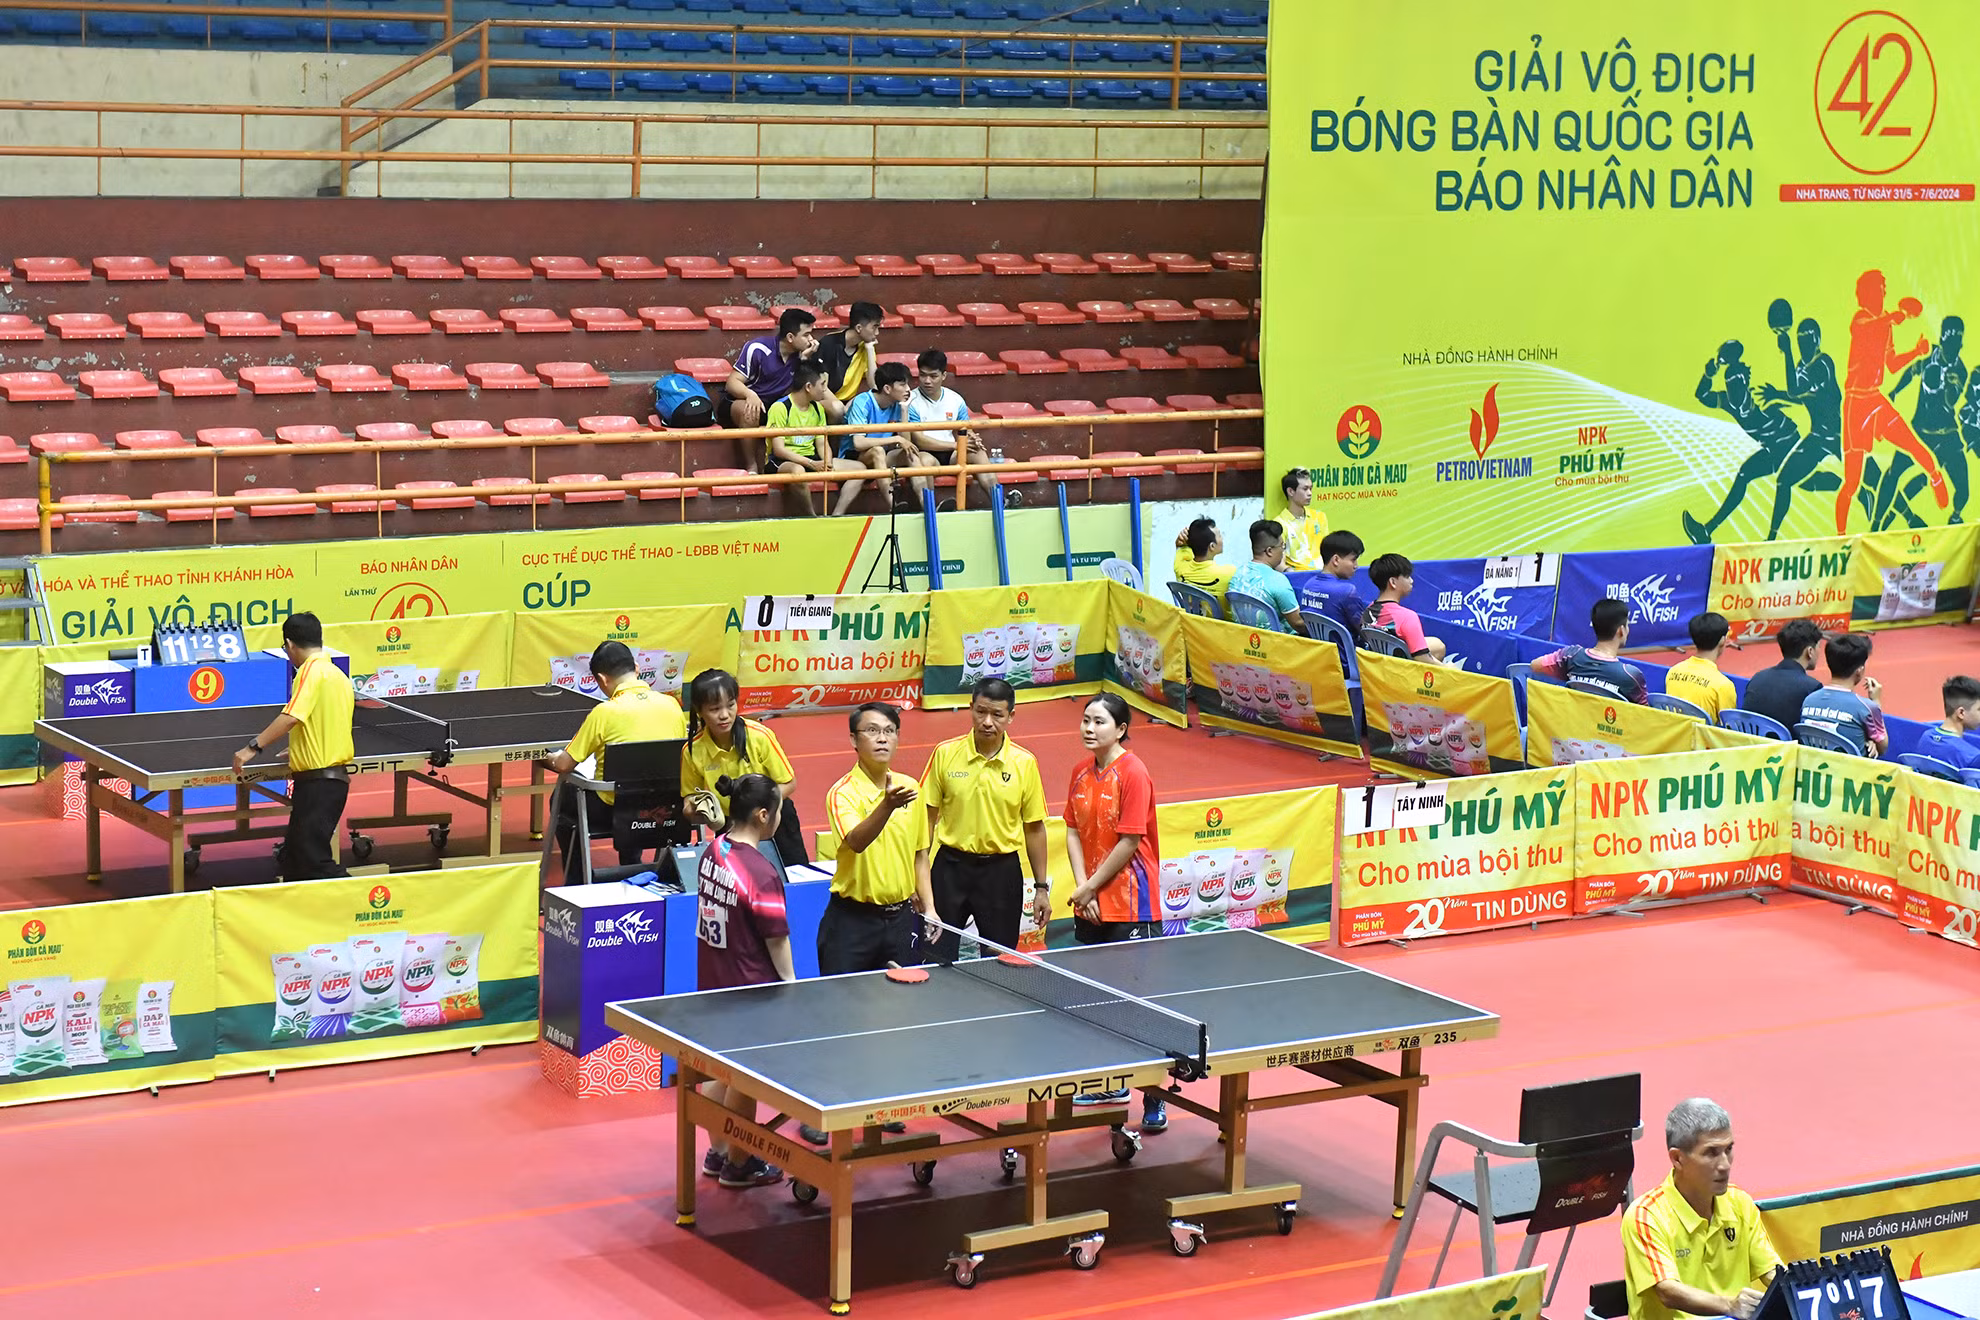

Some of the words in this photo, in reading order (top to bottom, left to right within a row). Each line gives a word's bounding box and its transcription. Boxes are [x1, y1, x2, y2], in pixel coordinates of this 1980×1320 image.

[1475, 34, 1562, 92] GIẢI
[1581, 37, 1636, 93] VÔ
[1652, 52, 1754, 103] ĐỊCH
[1827, 32, 1912, 136] 42
[1311, 96, 1436, 152] BÓNG
[1452, 96, 1539, 151] BÀN
[1554, 89, 1672, 152] QUỐC
[1686, 111, 1753, 150] GIA
[1436, 156, 1523, 211] BÁO
[1538, 154, 1655, 210] NHÂN
[1670, 154, 1752, 208] DÂN
[1796, 189, 1816, 199] NHA
[1818, 188, 1851, 200] TRANG,
[1853, 186, 1866, 199] TỪ
[1867, 186, 1892, 199] NGÀY
[1893, 188, 1912, 199] 31/5
[1920, 188, 1960, 199] 7/6/2024
[1403, 348, 1431, 365] NHÀ
[1436, 345, 1473, 364] ĐỒNG
[1478, 346, 1514, 362] HÀNH
[1518, 344, 1558, 361] CHÍNH
[1578, 426, 1607, 446] NPK
[1436, 457, 1532, 482] PETROVIETNAM
[1560, 449, 1594, 473] PHÚ
[1600, 447, 1625, 471] MỸ
[1310, 464, 1339, 488] PHÂN
[1343, 463, 1364, 486] BÓN
[1367, 462, 1381, 485] CÀ
[1385, 463, 1407, 483] MAU
[1555, 476, 1574, 486] Cho
[1614, 474, 1629, 483] thu
[1317, 493, 1331, 502] HẠT
[1333, 491, 1356, 501] NGỌC
[1358, 489, 1374, 499] MÙA
[1376, 488, 1398, 497] VÀNG
[361, 560, 387, 574] BÁO
[391, 557, 427, 572] NHÂN
[431, 555, 458, 571] DÂN
[522, 553, 549, 568] CỤC
[553, 546, 578, 564] THỂ
[581, 550, 608, 565] DỤC
[611, 542, 636, 561] THỂ
[640, 546, 673, 559] THAO
[685, 545, 719, 557] LĐBB
[722, 540, 750, 557] VIỆT
[753, 542, 779, 554] NAM
[1722, 558, 1762, 585] NPK
[1768, 548, 1813, 582] PHÚ
[1819, 545, 1852, 578] MỸ
[44, 577, 73, 592] HÓA
[78, 575, 97, 591] VÀ
[101, 570, 129, 589] THỂ
[134, 574, 173, 587] THAO
[177, 569, 210, 584] TỈNH
[214, 567, 262, 582] KHÁNH
[266, 565, 294, 580] HÒA
[1534, 555, 1544, 582] 1
[523, 572, 591, 609] CÚP
[1722, 594, 1754, 610] Cho
[1758, 593, 1791, 608] mùa
[1796, 589, 1819, 607] bội
[1823, 587, 1847, 602] thu
[62, 598, 133, 638] GIẢI
[757, 598, 774, 627] 0
[809, 605, 831, 617] GIANG
[819, 604, 884, 641] PHÚ
[1489, 616, 1517, 631] FISH
[1654, 606, 1679, 622] FISH
[162, 636, 189, 662] 11
[190, 637, 198, 649] 1
[201, 635, 214, 649] 2
[217, 634, 241, 659] 8
[755, 654, 799, 672] Cho
[806, 653, 853, 671] mùa
[861, 651, 895, 673] bội
[195, 671, 217, 699] 9
[849, 689, 877, 701] TIN
[69, 697, 98, 706] Double
[1591, 779, 1649, 819] NPK
[1659, 762, 1724, 813] PHÚ
[1735, 756, 1784, 804] MỸ
[1842, 774, 1895, 820] MỸ
[1362, 786, 1375, 828] 1
[1397, 796, 1416, 811] TÂY
[1418, 794, 1444, 809] NINH
[1429, 787, 1502, 839] PHÚ
[1513, 779, 1566, 830] MỸ
[1907, 795, 1961, 847] NPK
[1594, 832, 1642, 857] Cho
[1650, 828, 1696, 853] mùa
[1704, 820, 1739, 848] bội
[1747, 818, 1778, 841] thu
[1810, 820, 1844, 850] bội
[1853, 830, 1890, 858] thu
[1359, 861, 1409, 886] Cho
[1417, 855, 1471, 880] mùa
[1479, 846, 1518, 876] bội
[1527, 844, 1562, 867] thu
[1908, 849, 1949, 881] Cho
[1167, 887, 1191, 900] NPK
[1200, 877, 1225, 891] NPK
[1233, 876, 1256, 890] NPK
[1629, 870, 1675, 903] 20
[1698, 871, 1728, 890] TIN
[1732, 863, 1782, 885] DÙNG
[1802, 867, 1831, 888] TIN
[1836, 874, 1893, 902] DÙNG
[1353, 919, 1370, 932] PHÚ
[1372, 918, 1384, 929] MỸ
[1403, 899, 1446, 937] 20
[1443, 897, 1468, 908] Năm
[1472, 899, 1505, 920] TIN
[1511, 890, 1566, 916] DÙNG
[1943, 905, 1977, 943] 20
[587, 936, 623, 948] Double
[637, 933, 659, 943] FISH
[321, 976, 351, 992] NPK
[364, 966, 394, 982] NPK
[406, 964, 434, 980] NPK
[283, 980, 312, 993] NPK
[24, 1008, 55, 1024] NPK
[66, 1017, 92, 1027] KALI
[1434, 1031, 1456, 1044] 235
[1266, 1044, 1354, 1068] 世乒赛器材供应商
[1028, 1074, 1134, 1103] MOFIT
[966, 1099, 992, 1110] Double
[993, 1097, 1010, 1106] FISH
[766, 1143, 790, 1163] FISH
[1841, 1229, 1865, 1243] NHÀ
[1868, 1220, 1898, 1239] ĐỒNG
[1901, 1216, 1932, 1233] HÀNH
[1934, 1210, 1968, 1226] CHÍNH
[1797, 1288, 1822, 1320] 7
[1826, 1282, 1840, 1303] 0
[1843, 1279, 1855, 1300] 1
[1860, 1276, 1884, 1318] 7
